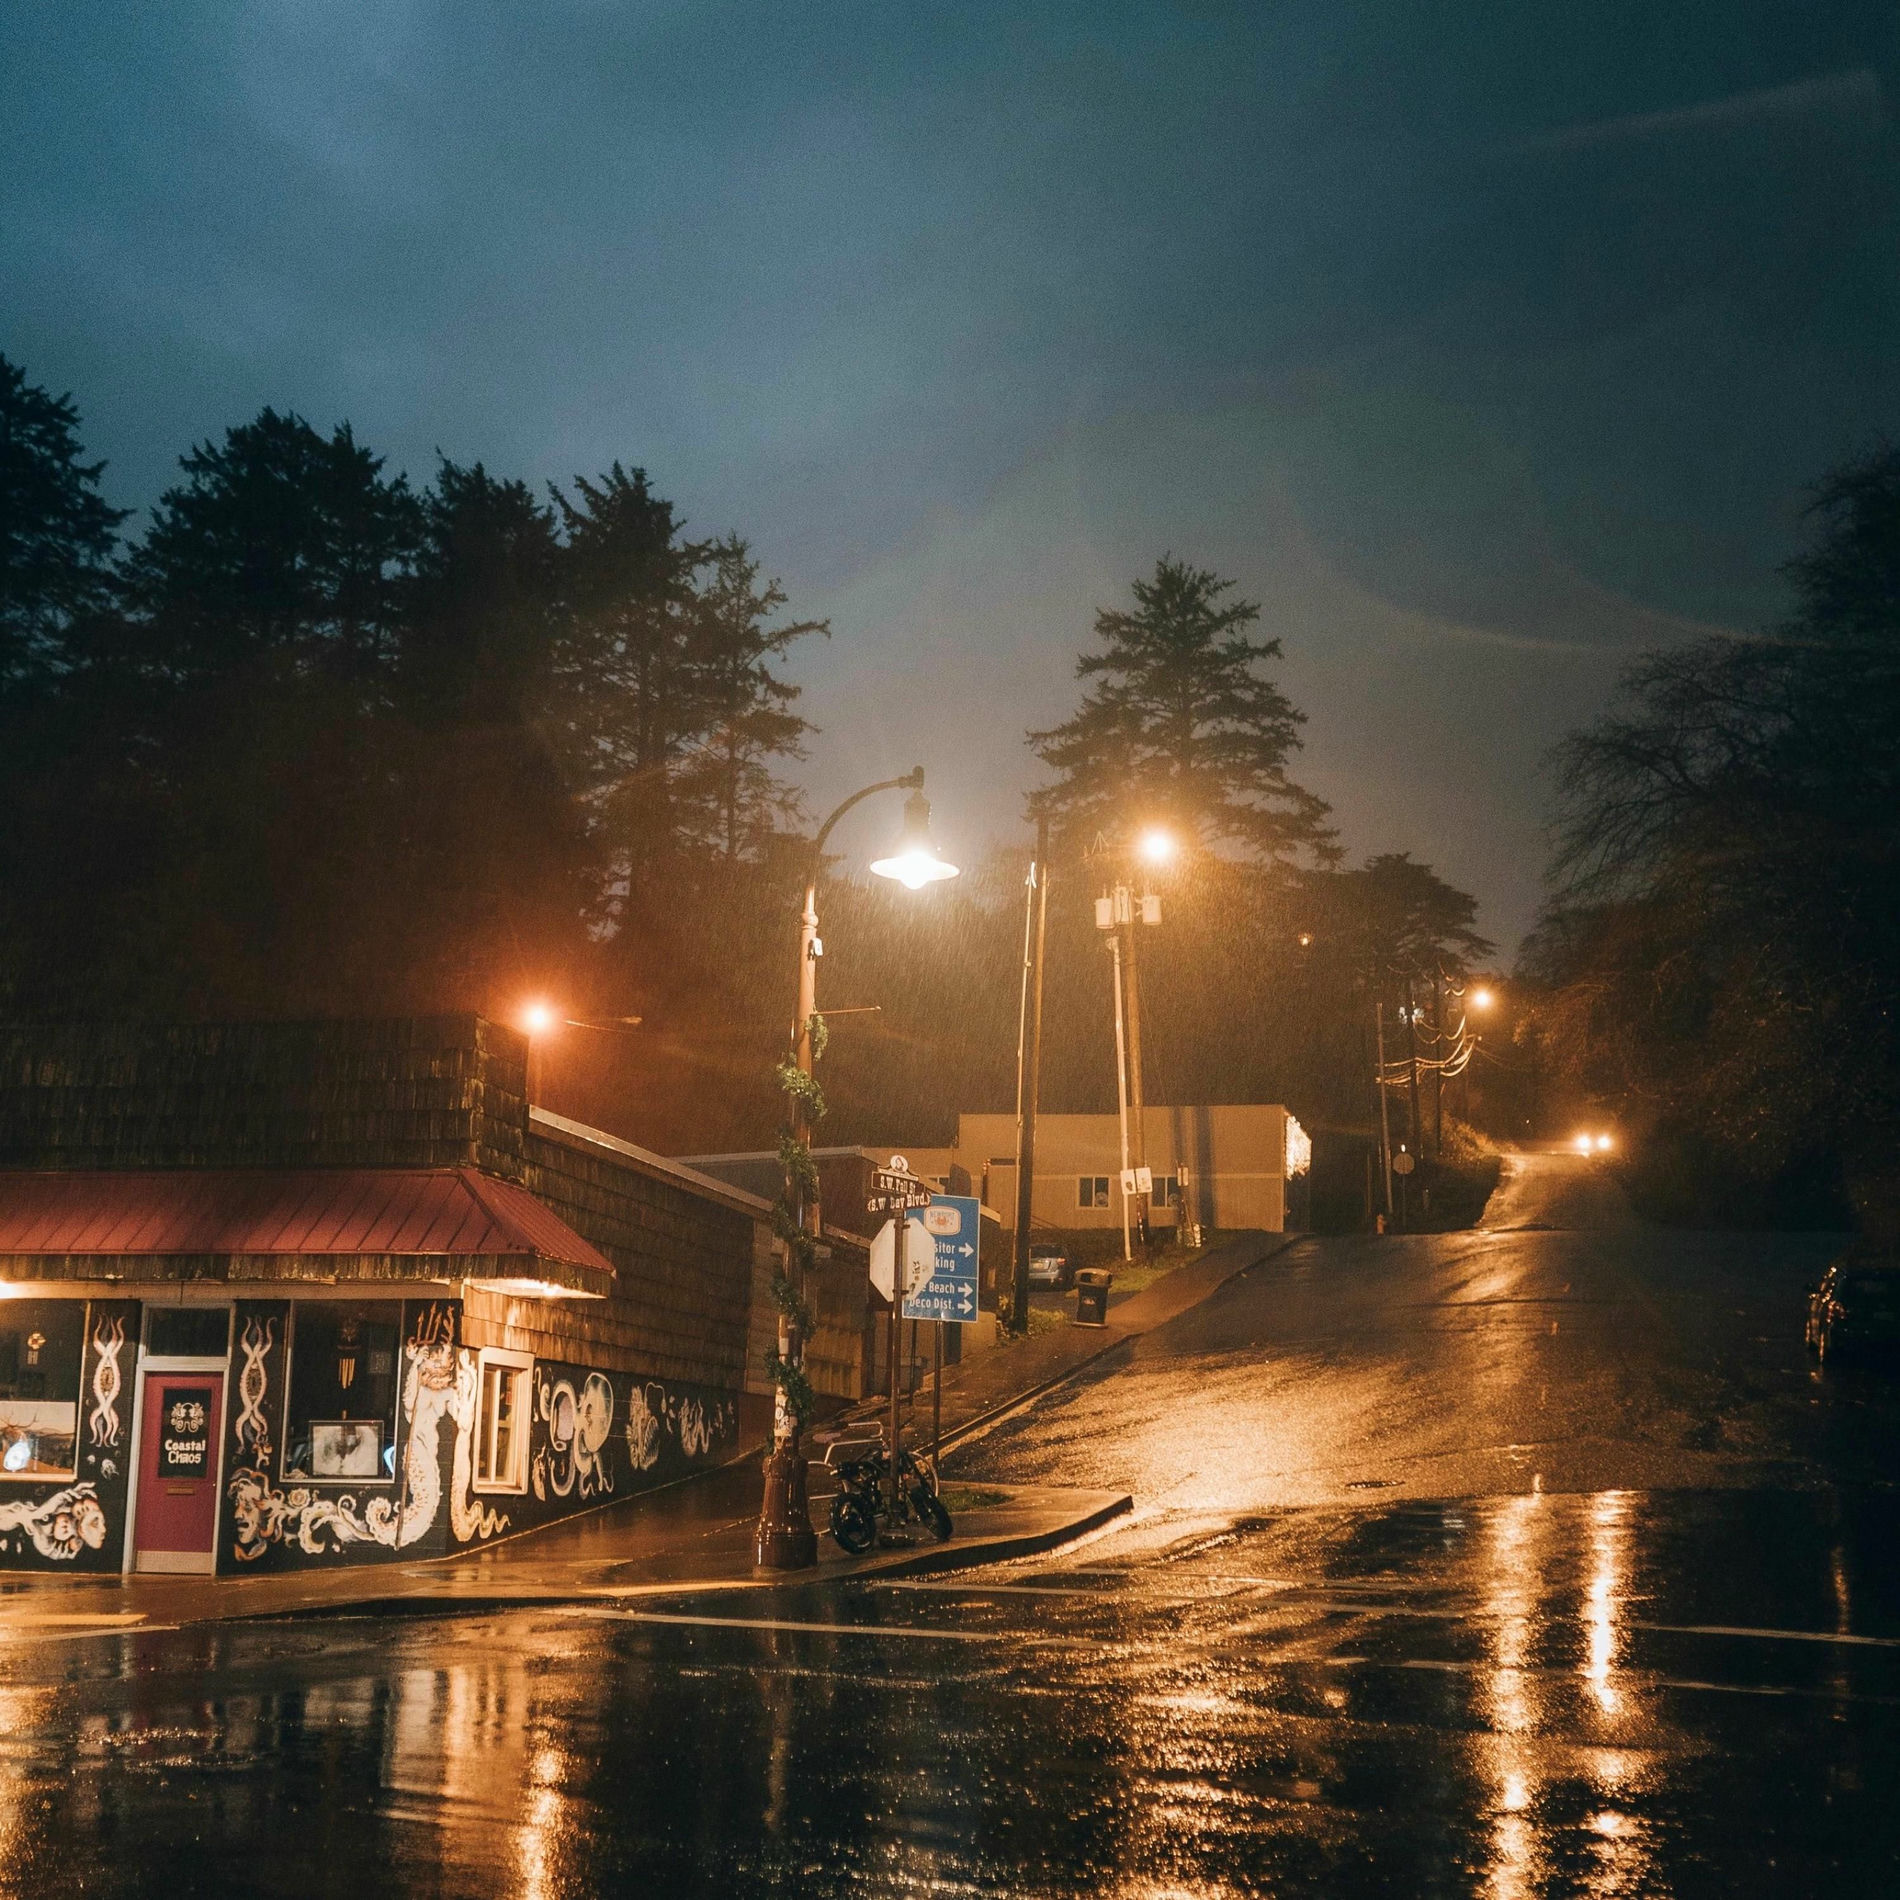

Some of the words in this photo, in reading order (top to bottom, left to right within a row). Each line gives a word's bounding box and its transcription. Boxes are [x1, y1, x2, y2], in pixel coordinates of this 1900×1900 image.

[895, 1178, 908, 1193] Fall
[934, 1242, 956, 1254] sitor
[935, 1256, 956, 1272] king
[928, 1281, 955, 1294] Beach
[909, 1297, 932, 1309] Deco
[933, 1297, 955, 1310] Dist.
[164, 1439, 206, 1452] Coastal
[167, 1451, 202, 1464] Chaos
